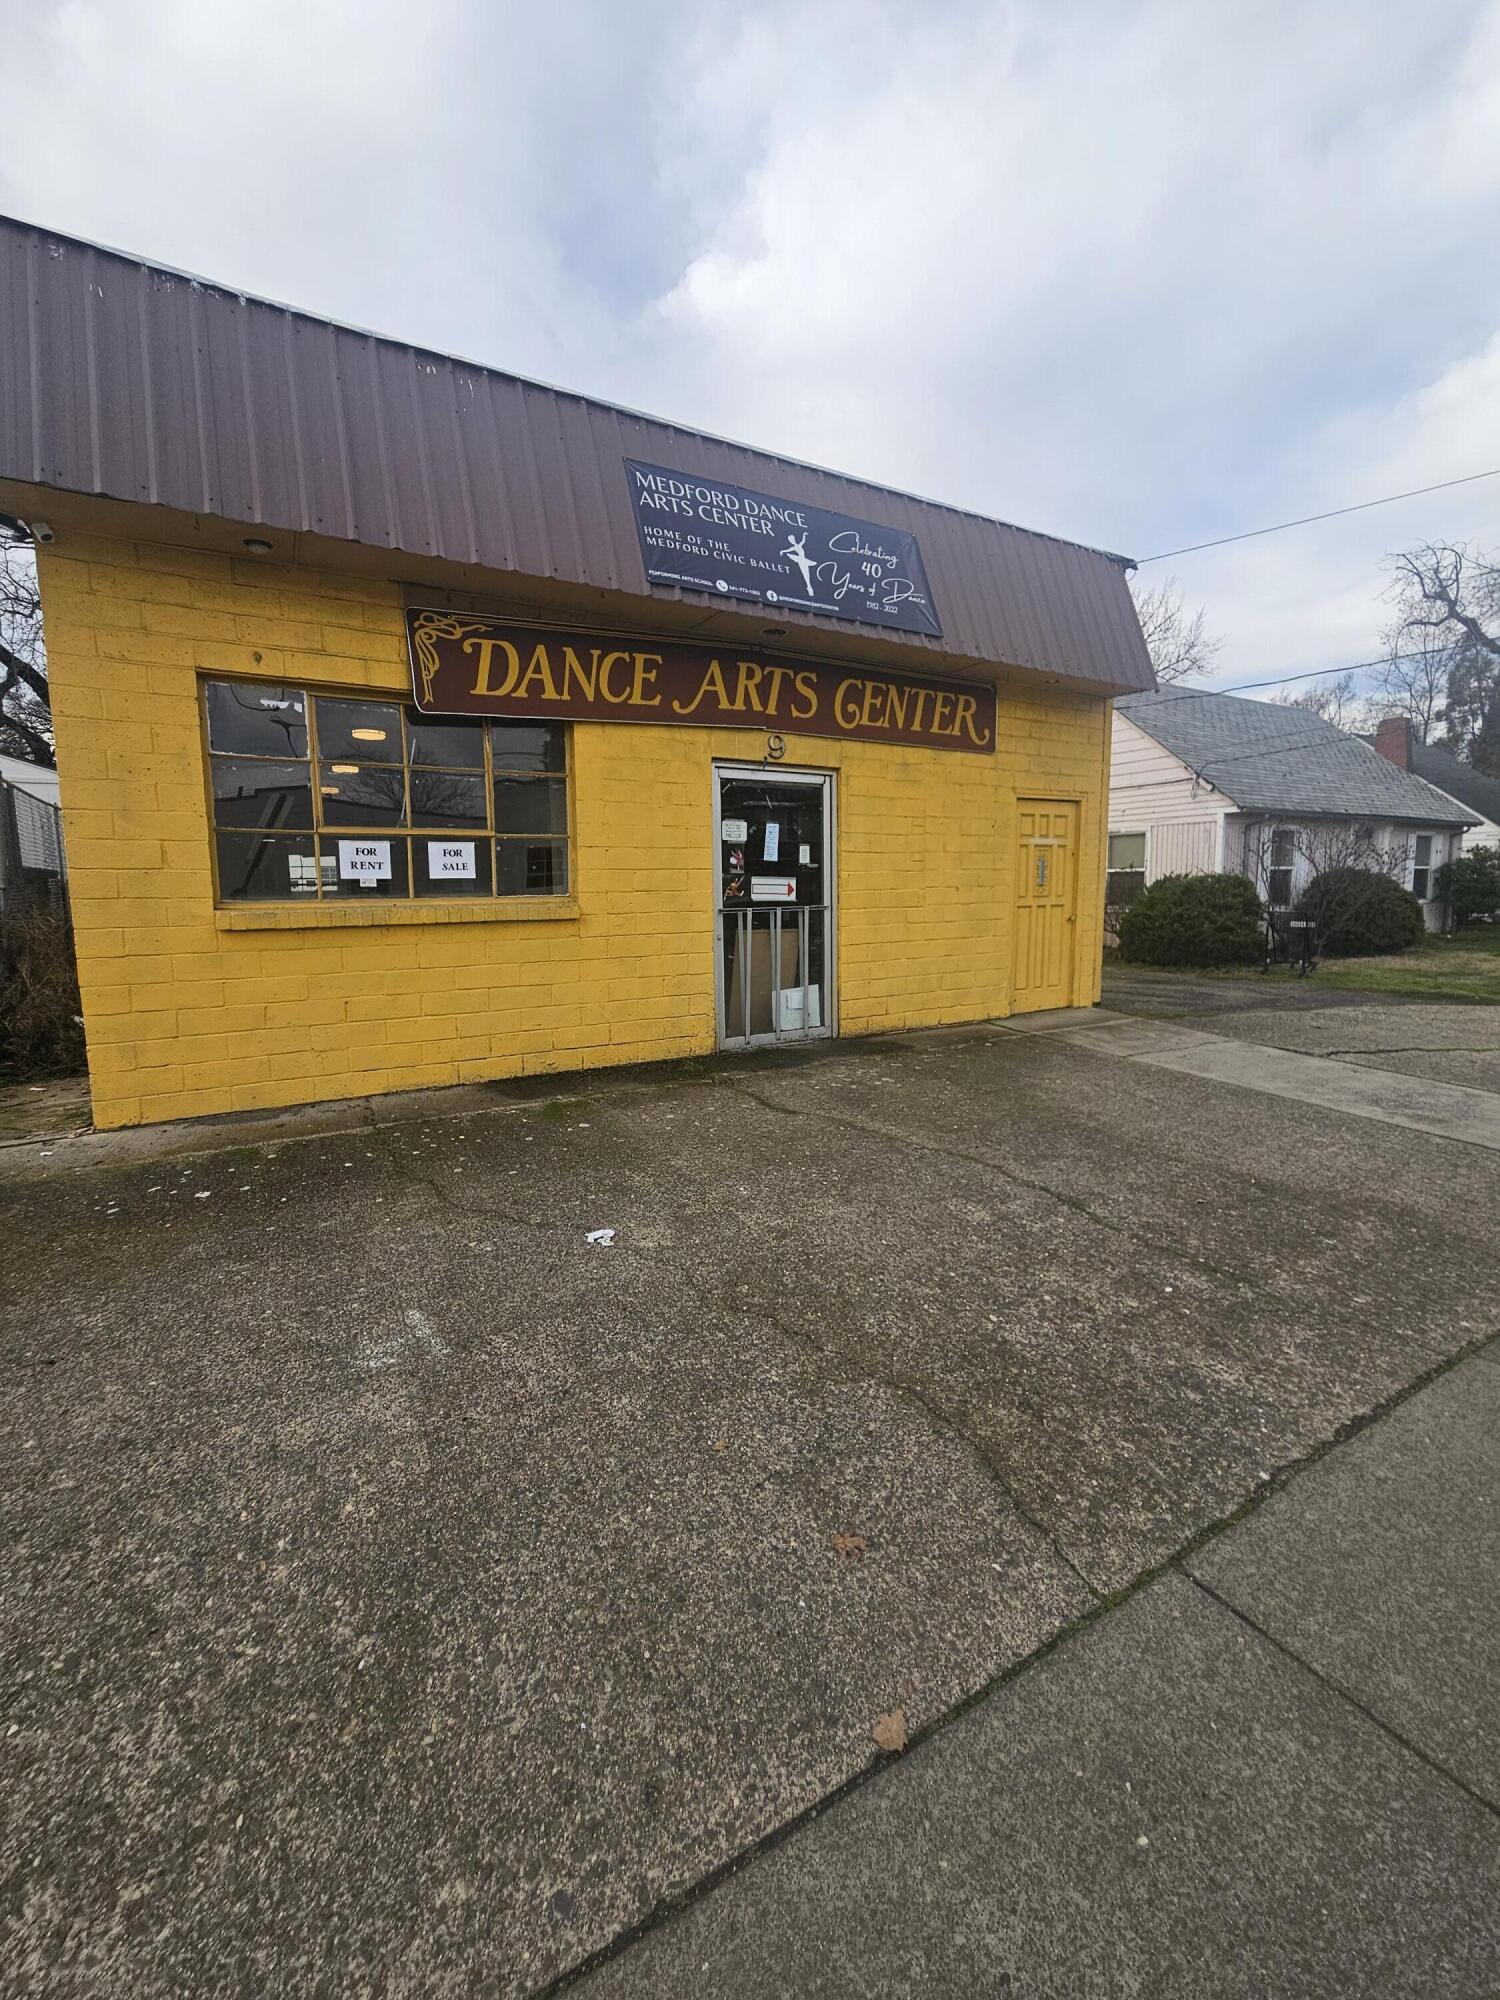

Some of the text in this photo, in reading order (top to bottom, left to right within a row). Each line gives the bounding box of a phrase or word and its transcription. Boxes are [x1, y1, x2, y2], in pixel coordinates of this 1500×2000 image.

[635, 471, 808, 528] MEDFORD DANCE
[639, 491, 775, 537] ARTS CENTER
[643, 525, 731, 552] HOME OF THE
[829, 531, 899, 568] Celebrating
[646, 537, 791, 574] MEDFORD CIVIC BALLET
[816, 561, 927, 604] Years of Dance
[861, 561, 882, 578] 40
[462, 637, 990, 745] DANCE ARTS CENTER
[767, 734, 786, 760] 9
[350, 861, 384, 870] RENT
[355, 847, 377, 857] FOR
[442, 848, 463, 858] FOR
[441, 862, 469, 871] SALE
